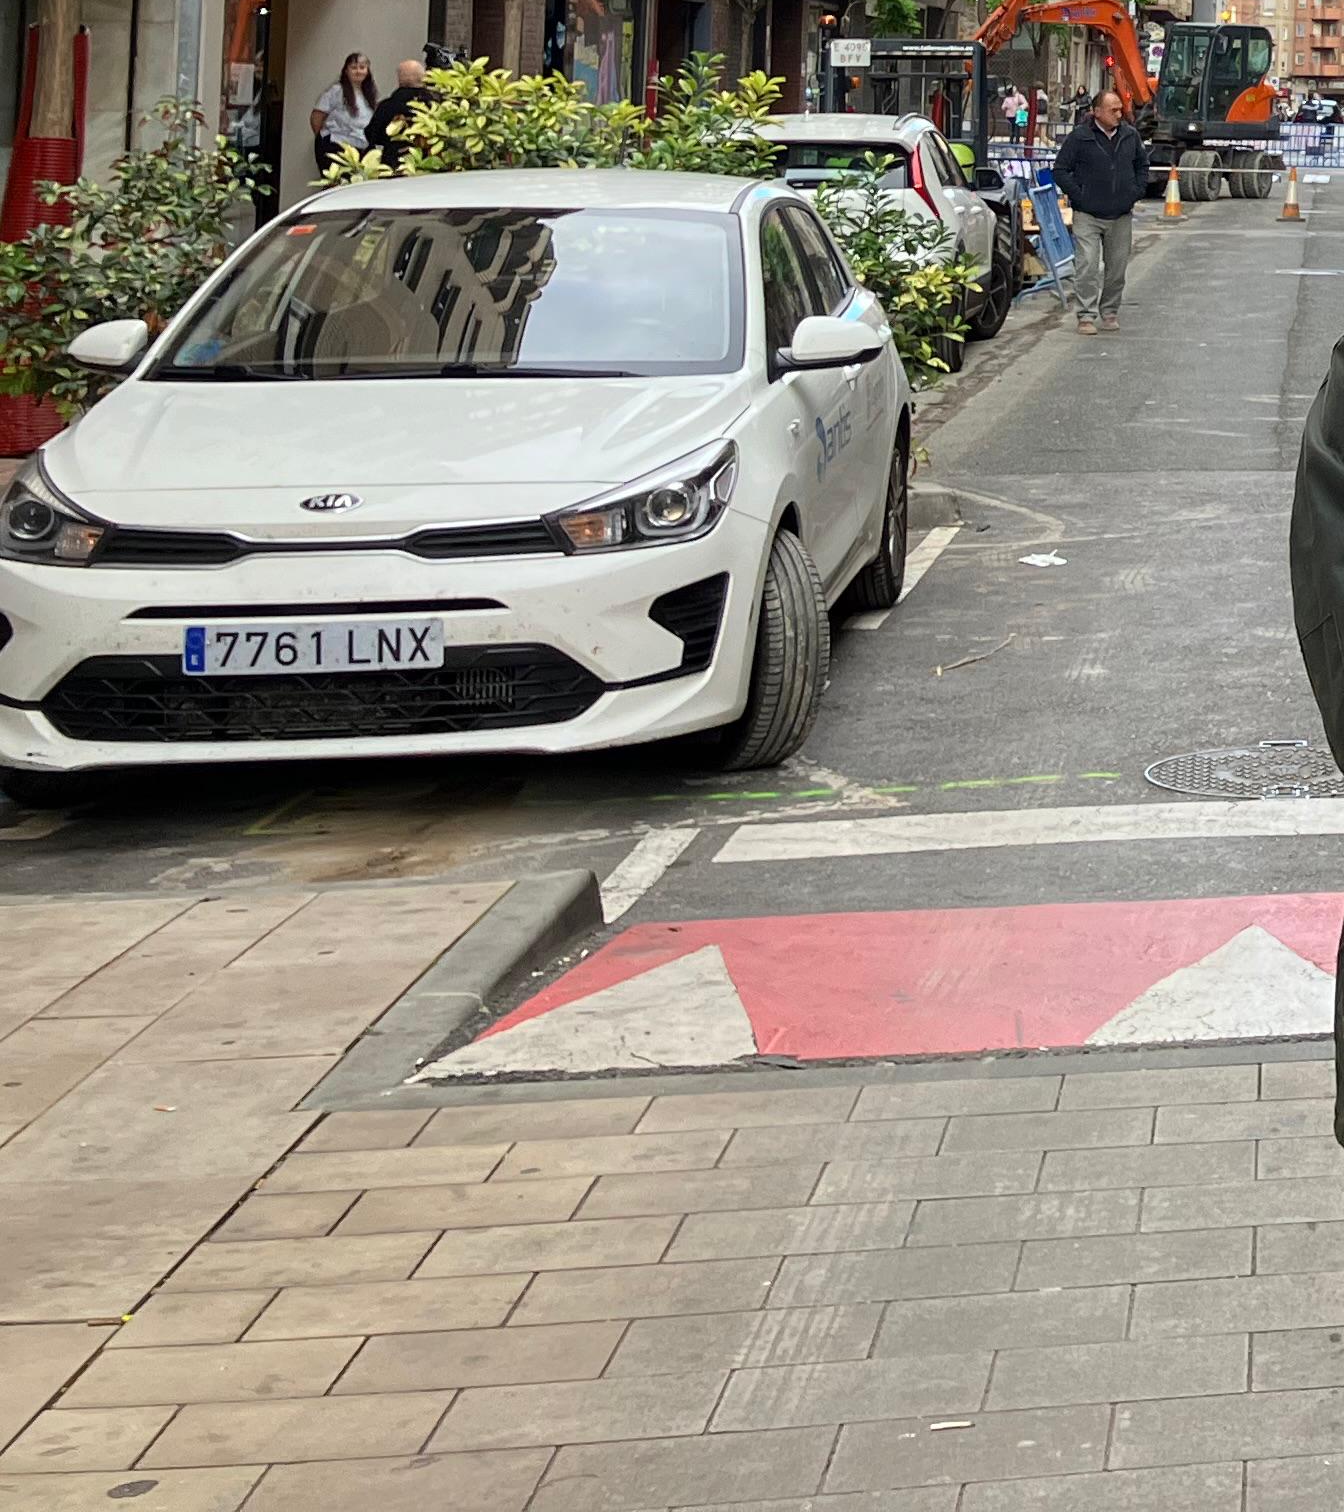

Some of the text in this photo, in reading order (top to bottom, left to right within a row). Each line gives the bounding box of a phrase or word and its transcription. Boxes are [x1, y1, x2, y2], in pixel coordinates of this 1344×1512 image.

[308, 494, 353, 510] KIA
[215, 625, 432, 669] 7761 LNX
